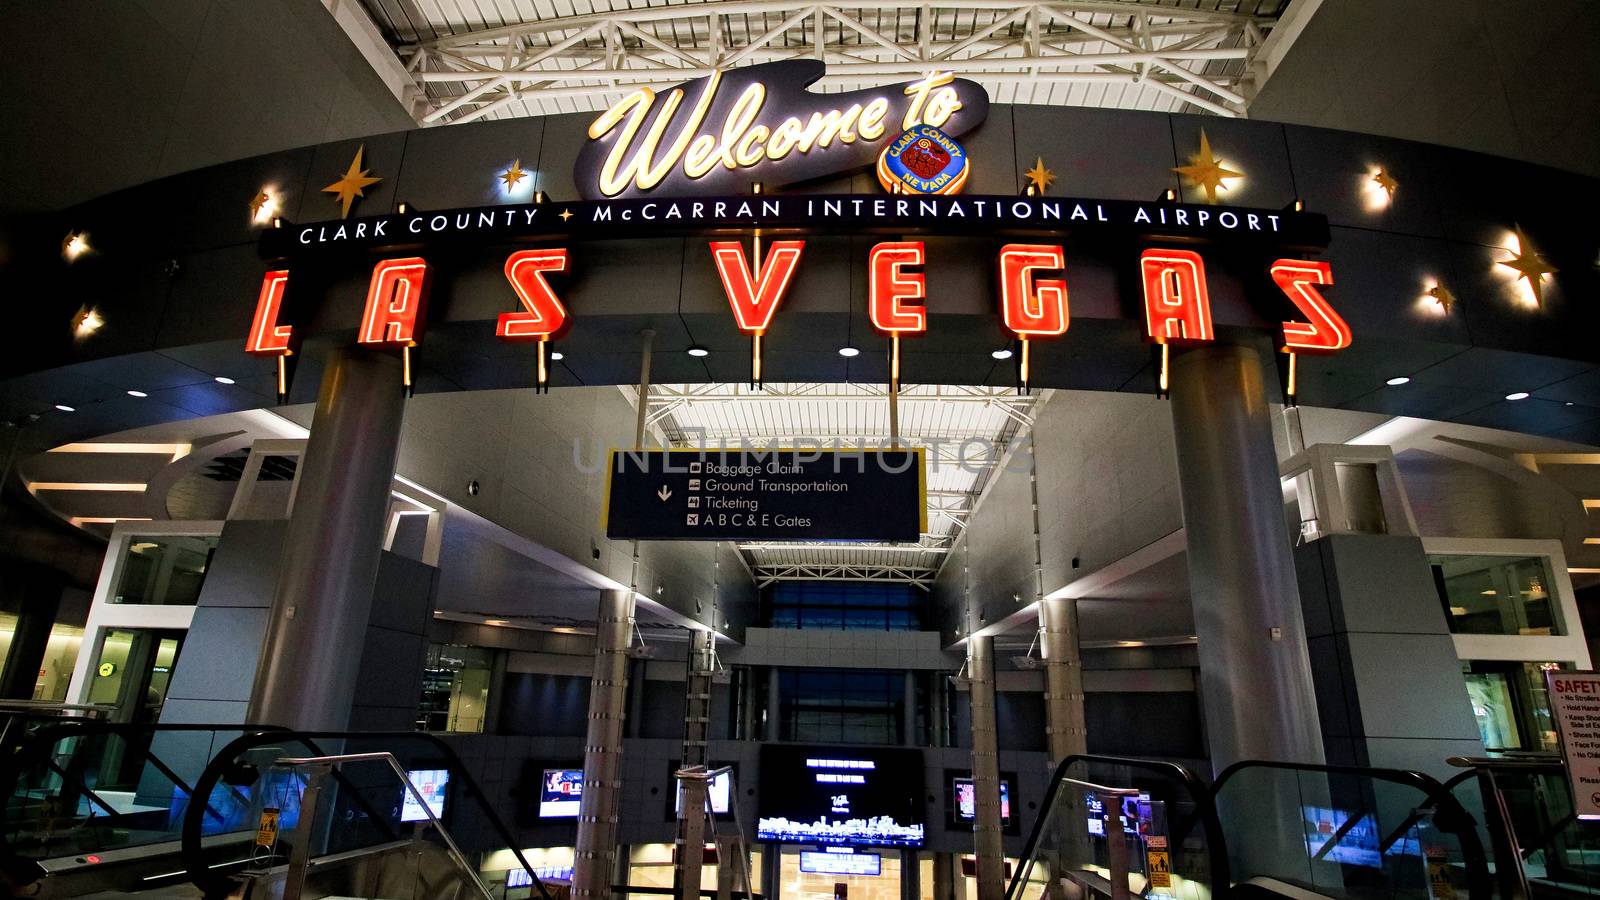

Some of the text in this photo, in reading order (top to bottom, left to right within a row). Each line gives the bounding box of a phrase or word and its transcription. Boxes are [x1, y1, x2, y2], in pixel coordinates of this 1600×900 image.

[588, 68, 963, 196] Welcome to
[889, 127, 962, 158] CLARK COUNTY
[902, 172, 952, 190] NEVADA
[299, 200, 1280, 245] CLARK COUNTY McCARRAN INTERNATIONAL AIRPORT
[245, 241, 1352, 353] LAS VEGAS
[706, 462, 804, 476] Baggage Claim
[705, 479, 848, 493] Ground Transportation
[705, 497, 758, 510] Ticketing
[703, 515, 812, 527] A B C & E Gates
